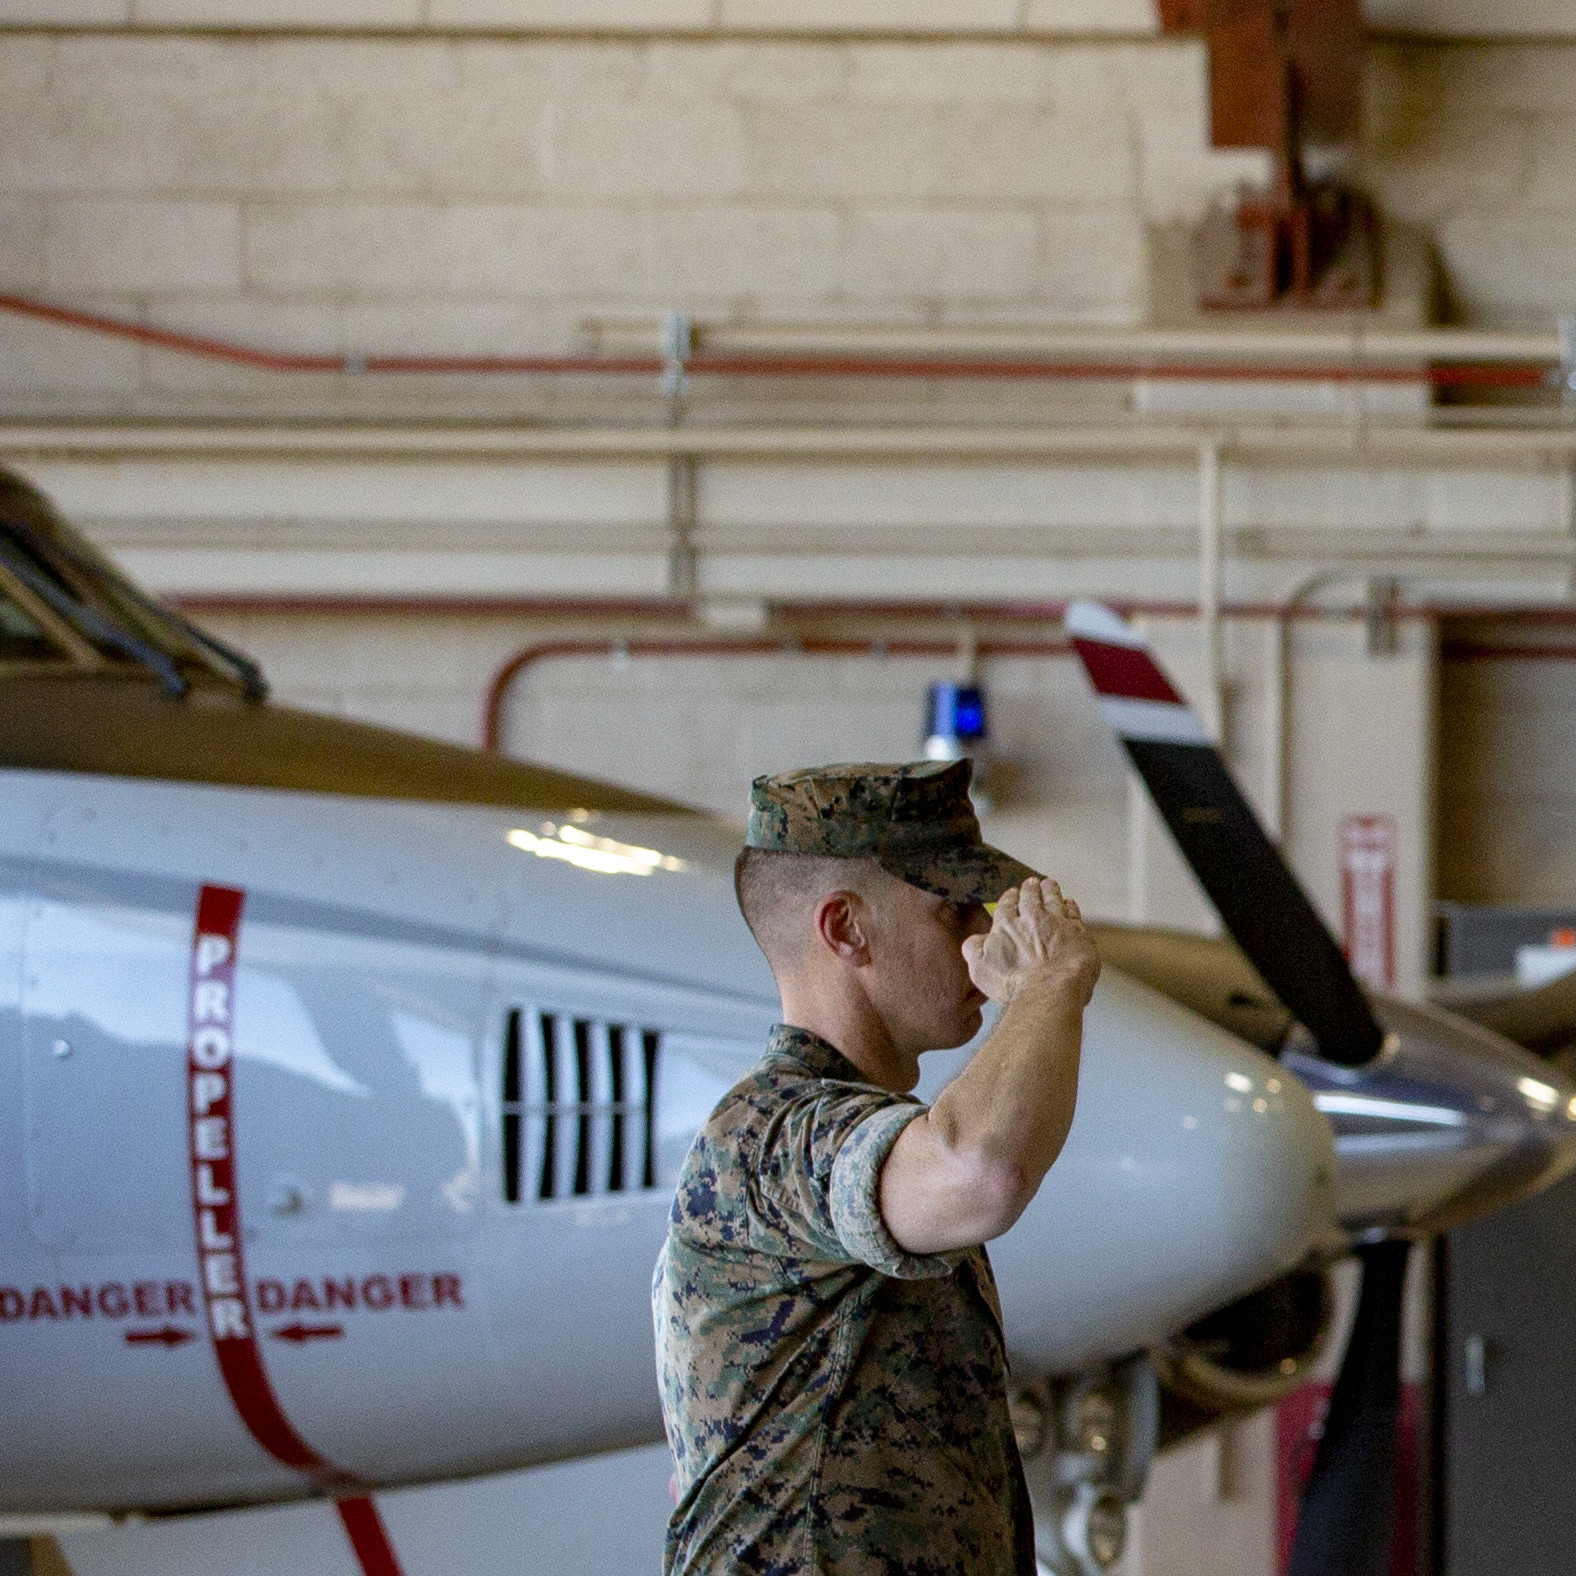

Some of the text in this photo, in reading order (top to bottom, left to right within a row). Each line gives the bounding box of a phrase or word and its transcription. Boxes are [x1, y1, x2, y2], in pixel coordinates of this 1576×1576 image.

[193, 933, 250, 1340] PROPELLER
[0, 1280, 196, 1325] DANGER
[255, 1271, 465, 1315] DANGER
